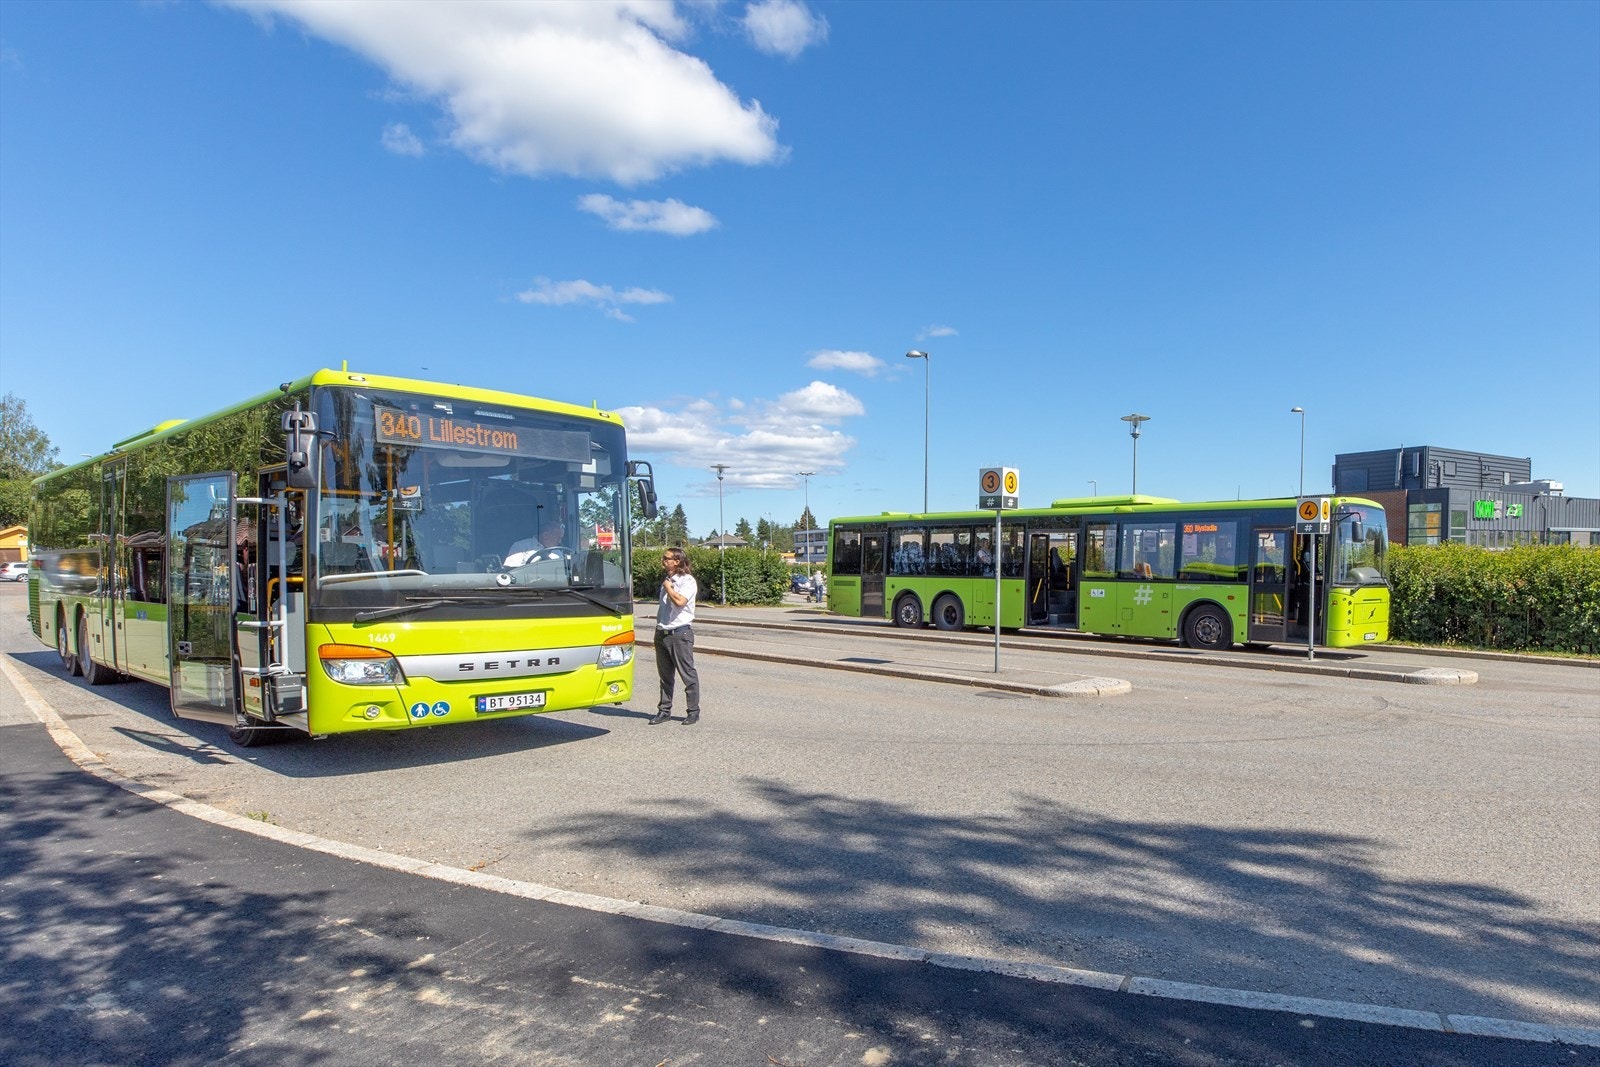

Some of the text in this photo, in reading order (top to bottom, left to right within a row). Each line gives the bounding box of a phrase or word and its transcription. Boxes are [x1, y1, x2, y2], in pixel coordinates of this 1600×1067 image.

[381, 411, 518, 450] 340 Lillestrøm
[987, 475, 995, 489] 3
[1008, 475, 1014, 489] 3
[1304, 504, 1313, 517] 4
[1474, 500, 1495, 519] KIWI
[368, 633, 396, 643] 1469
[458, 657, 560, 672] SETRA
[489, 694, 542, 709] BT 95134
